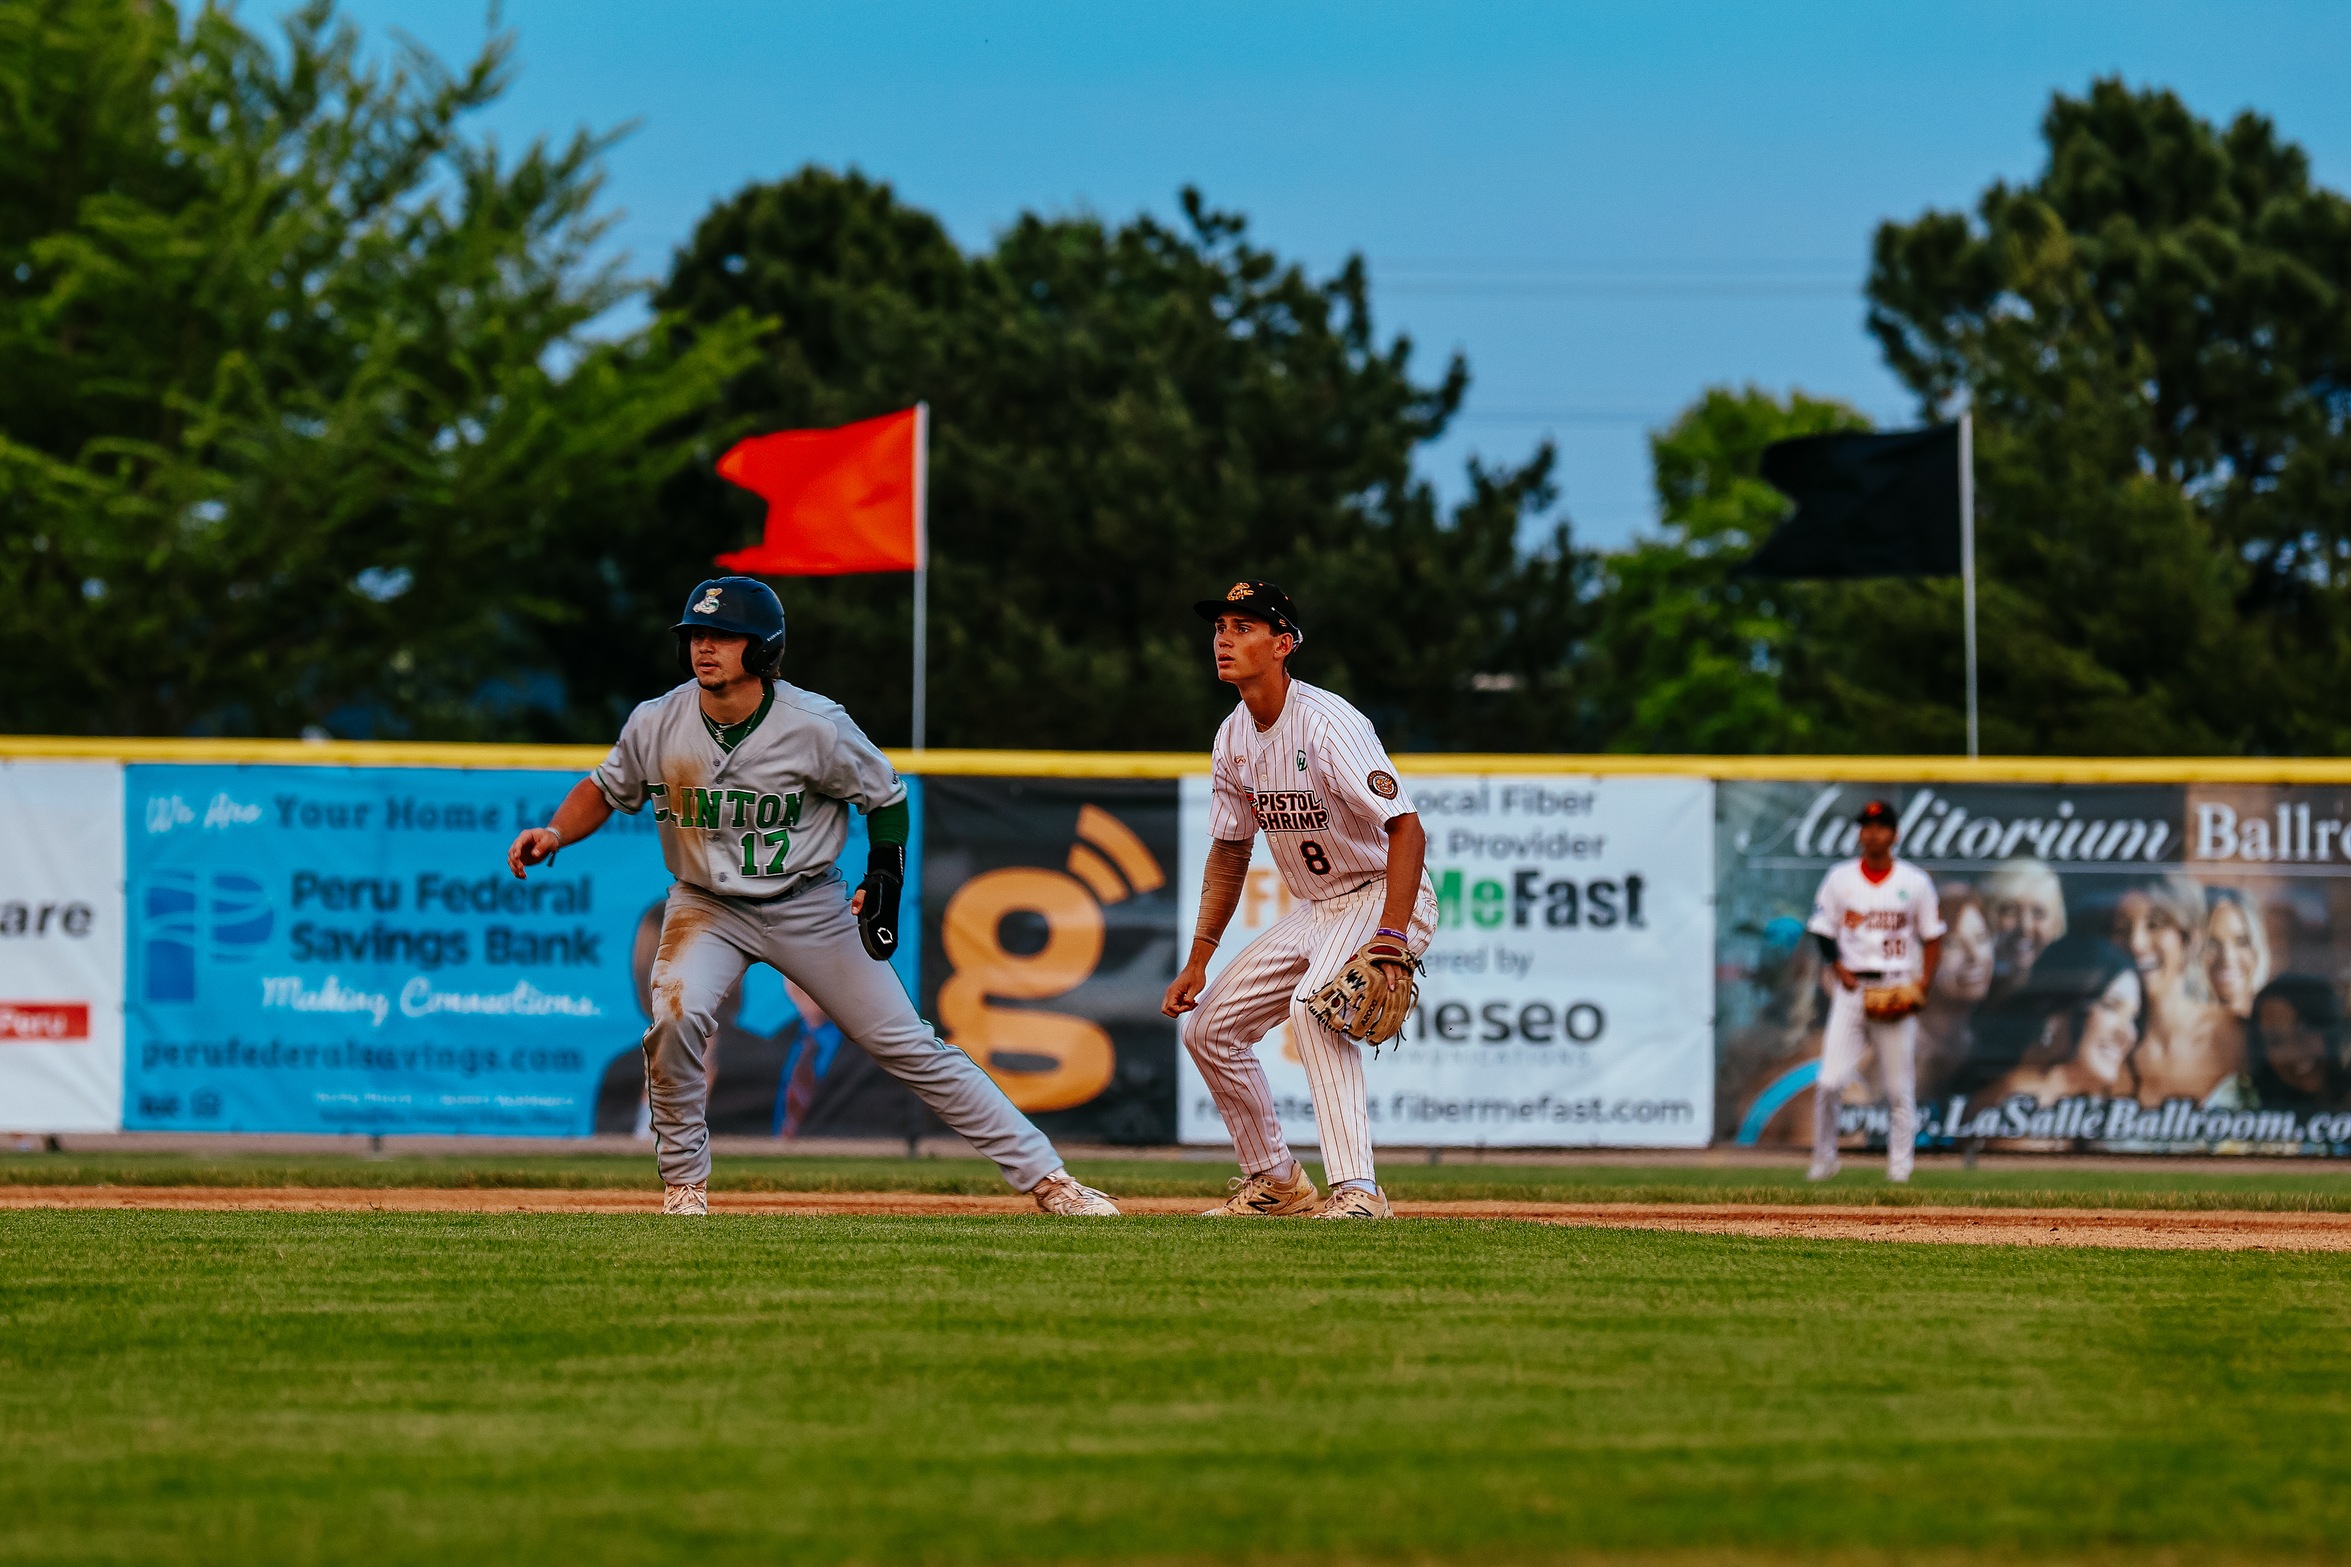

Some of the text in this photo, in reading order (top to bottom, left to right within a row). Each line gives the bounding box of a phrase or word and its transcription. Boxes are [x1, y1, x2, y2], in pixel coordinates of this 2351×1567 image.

[273, 793, 370, 831] Your
[384, 795, 501, 833] Home
[1257, 791, 1322, 813] PISTOL
[1412, 779, 1491, 816] ocal
[1499, 784, 1595, 817] Fiber
[1257, 810, 1330, 832] SHRIMP
[1734, 784, 2172, 862] Auitorium
[739, 828, 791, 877] 17
[1300, 840, 1332, 876] 8
[1449, 827, 1608, 861] Provider
[291, 870, 593, 915] Peru Federal
[1243, 868, 1648, 930] FiMeFast
[291, 921, 604, 971] Savings Bank
[1424, 945, 1488, 975] ered
[1360, 999, 1379, 1028] A2000
[1409, 1000, 1607, 1045] eseo
[141, 1036, 586, 1077] perufederalsavings.com
[1391, 1089, 1696, 1124] fibermefast.com
